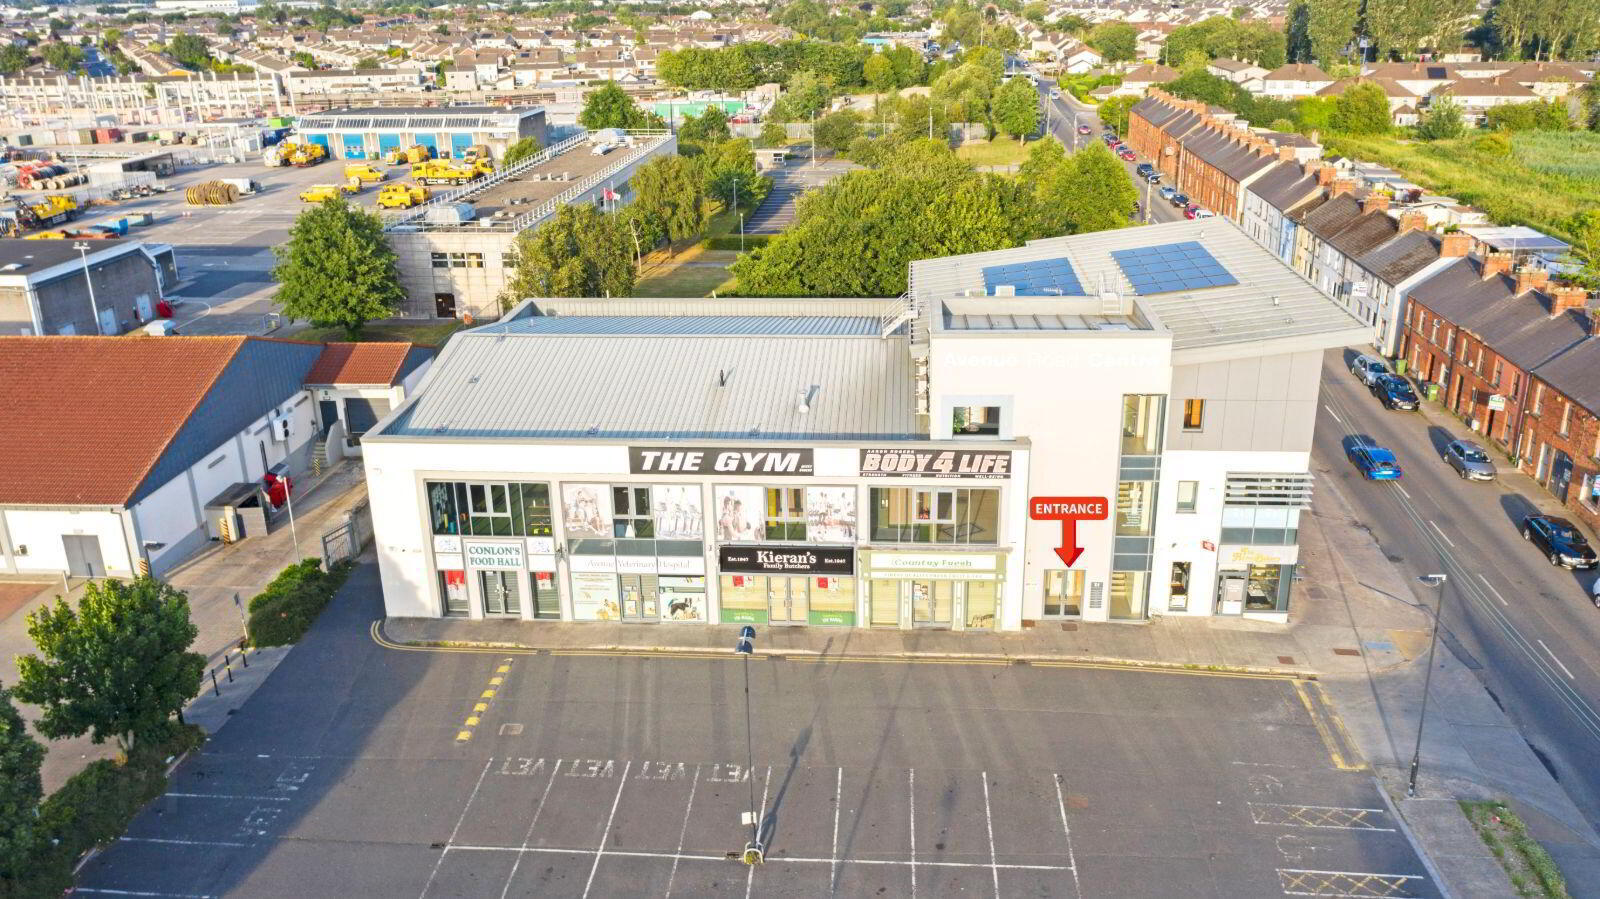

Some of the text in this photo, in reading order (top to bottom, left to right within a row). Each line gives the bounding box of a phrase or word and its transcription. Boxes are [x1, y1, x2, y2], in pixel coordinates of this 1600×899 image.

[640, 451, 704, 471] THE
[714, 452, 800, 472] GYM
[862, 451, 1010, 473] BODY 4 LIFE
[469, 546, 521, 555] CONLON'S
[470, 557, 521, 567] FOOD HALL
[756, 550, 817, 564] Kieran's
[763, 562, 783, 570] Family
